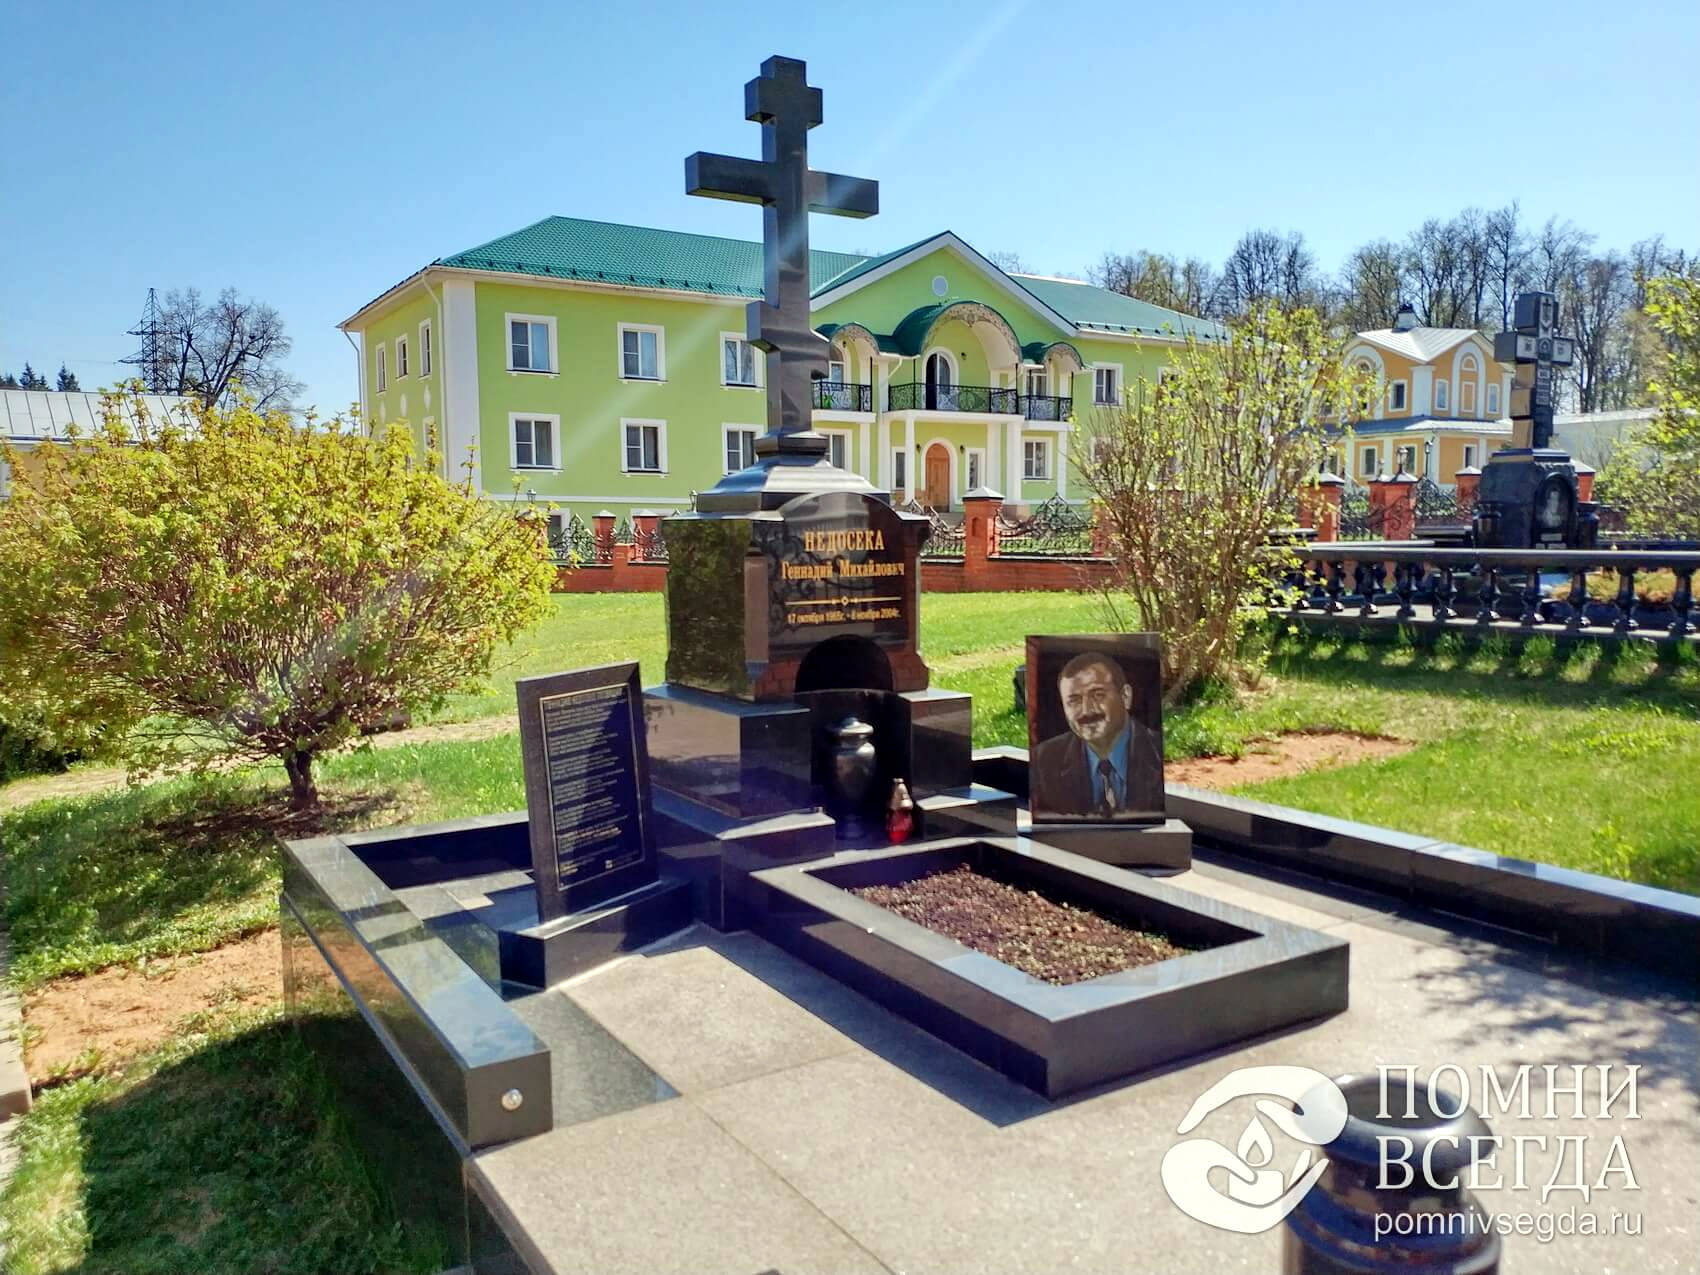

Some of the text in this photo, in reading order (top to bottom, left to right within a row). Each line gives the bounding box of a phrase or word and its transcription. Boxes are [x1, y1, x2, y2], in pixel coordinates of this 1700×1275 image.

[804, 530, 885, 554] НЕДОСЕКА
[782, 559, 905, 581] Геннадий Михайлович
